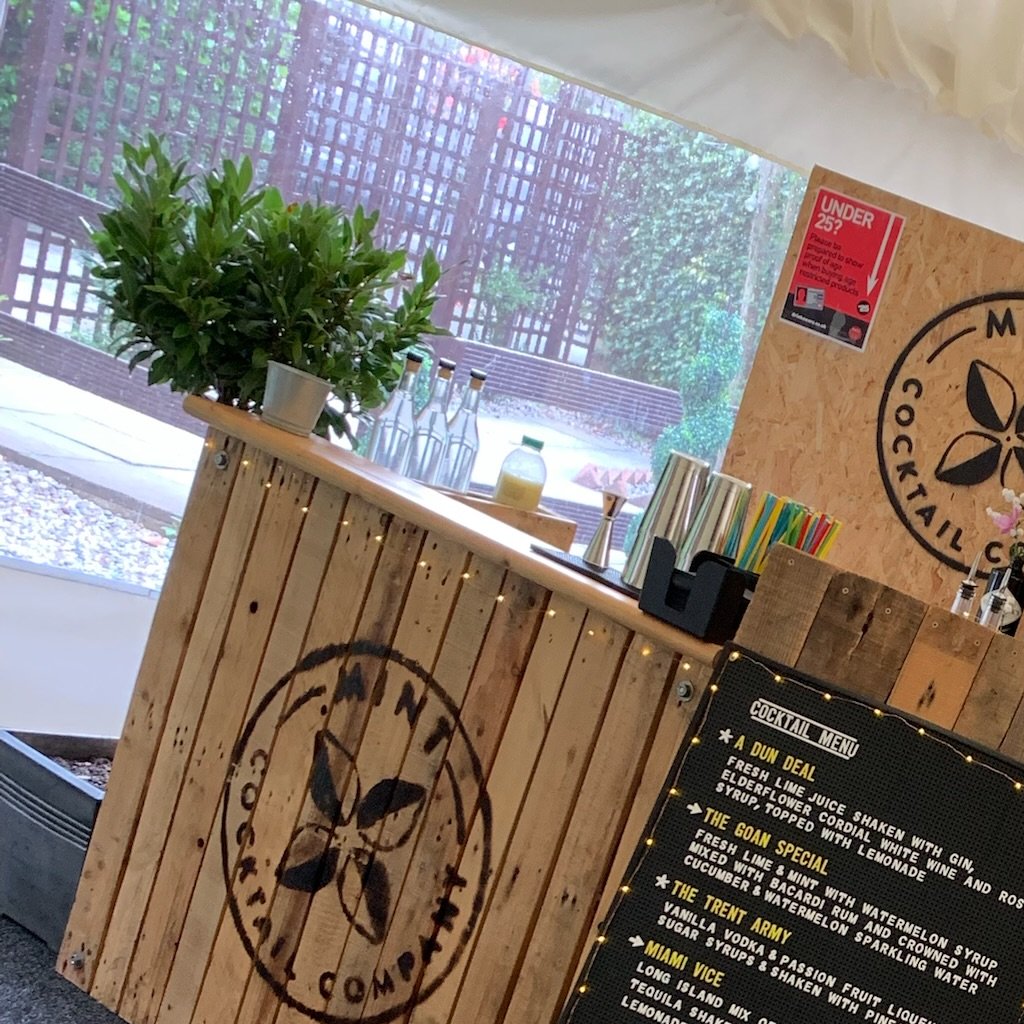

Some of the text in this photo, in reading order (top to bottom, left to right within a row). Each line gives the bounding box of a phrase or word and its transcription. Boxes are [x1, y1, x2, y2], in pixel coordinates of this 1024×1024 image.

[809, 232, 832, 247] Please
[814, 213, 843, 236] 25?
[820, 195, 875, 230] UNDER
[801, 259, 820, 272] when
[803, 250, 822, 264] proof
[822, 257, 830, 265] of
[830, 280, 859, 297] products
[893, 378, 962, 552] COCKTAIL
[333, 662, 451, 754] MINT
[749, 700, 860, 759] COCKTAIL MENU
[733, 734, 815, 781] A DUN DEAL
[703, 807, 828, 875] THE GOAN SPECIAL
[715, 782, 926, 882] SYRUP, TOPPED WITH LEMONADE
[720, 768, 811, 816] ELDERFLOWER
[818, 811, 870, 842] CORDIAL
[880, 837, 919, 863] WHITE
[926, 857, 957, 880] WINE
[963, 875, 991, 894] AND
[726, 755, 974, 873] FRESH LIME JUICE SHAKEN WITH GIN,
[671, 879, 792, 944] THE TRENT ARMY
[683, 854, 978, 994] CUCUMBER & WATERMELON SPARKLING WATER
[688, 841, 997, 987] MIXED WITH BACARDI RUM AND CROWNED WITH
[694, 828, 998, 970] FRESH LIME & MINT WITH WATERMELON SYRUP
[319, 864, 467, 1003] COMPANY
[643, 939, 725, 987] MIAMI VICE
[657, 914, 699, 940] SUGAR
[705, 936, 755, 965] SYRUPS
[758, 960, 767, 971] &
[770, 966, 822, 996] SHAKEN
[827, 991, 859, 1014] WITH
[663, 901, 715, 933] VANILLA
[724, 928, 764, 956] VODKA
[767, 949, 777, 960] &
[779, 954, 836, 987] PASSION
[841, 982, 881, 1007] FRUIT
[630, 977, 682, 1011] TEQUILA
[636, 961, 671, 984] LONG
[675, 979, 723, 1008] ISLAND
[727, 1003, 751, 1021] MIX
